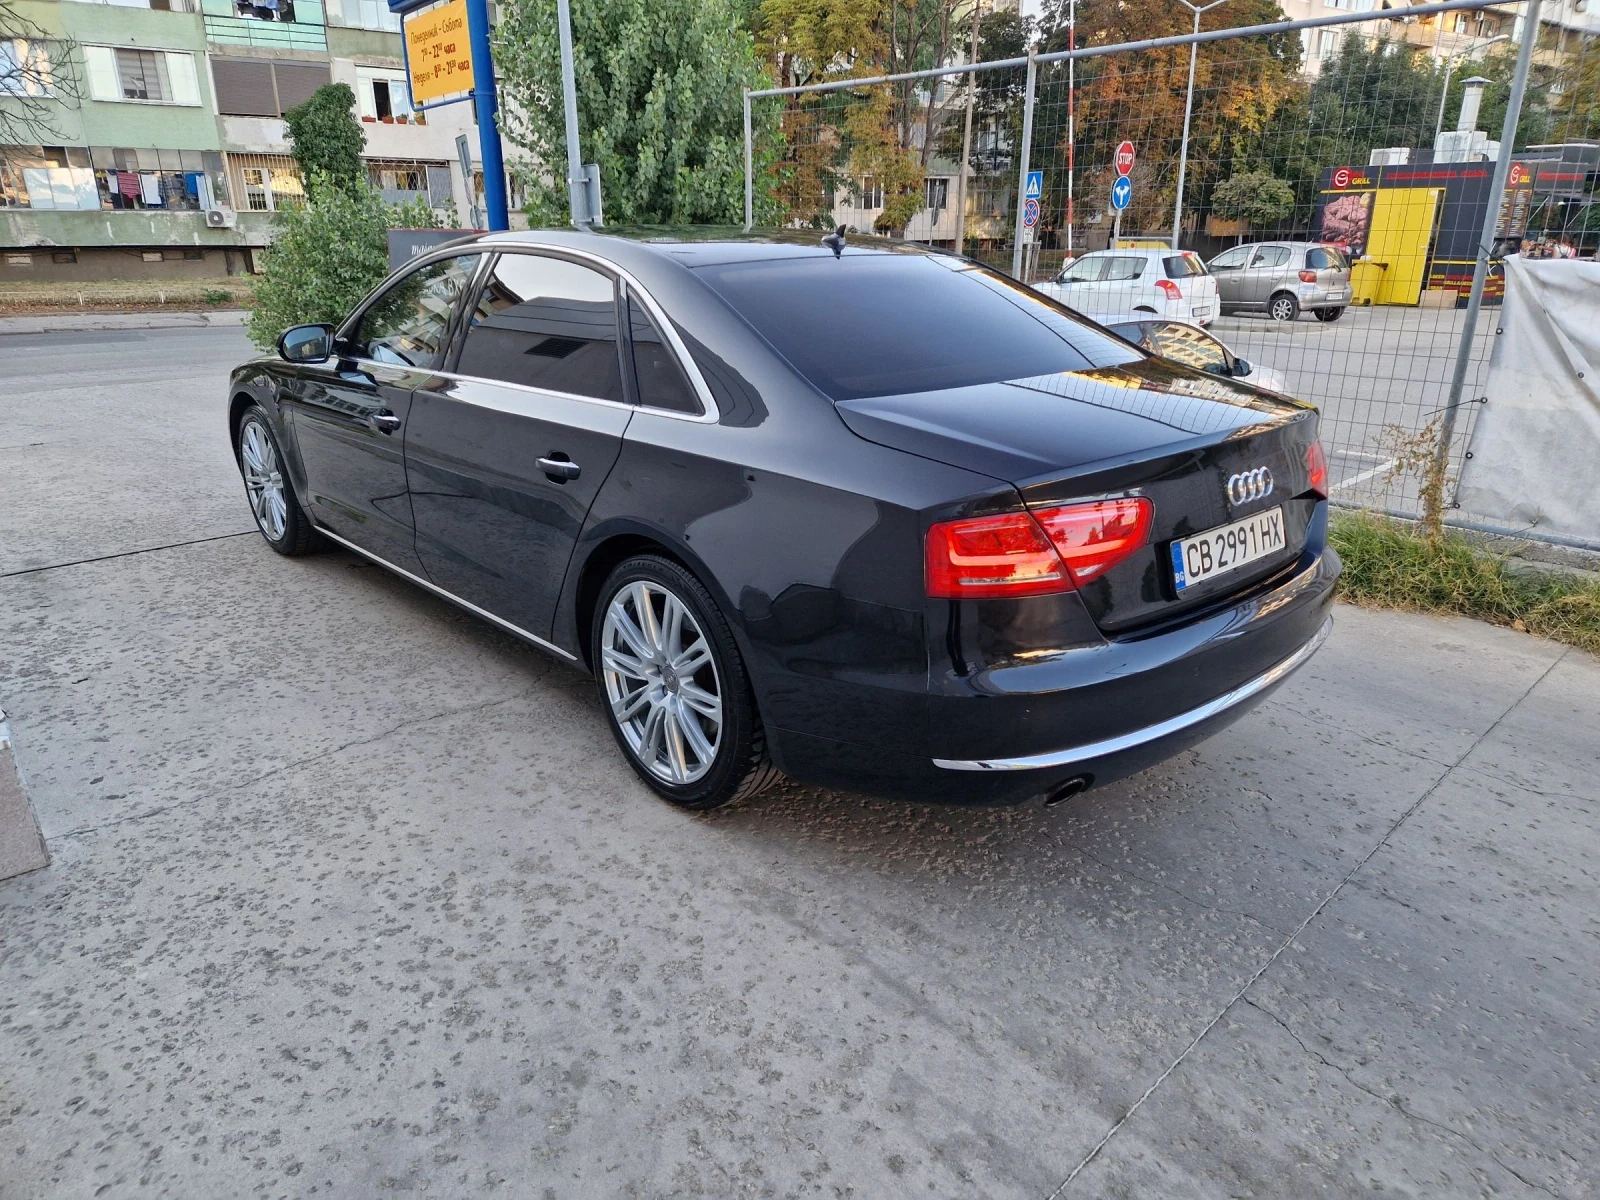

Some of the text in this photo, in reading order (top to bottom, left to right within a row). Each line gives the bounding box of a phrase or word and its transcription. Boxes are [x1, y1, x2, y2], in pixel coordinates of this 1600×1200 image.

[442, 18, 462, 33] Събота
[444, 43, 456, 54] часа
[413, 72, 430, 86] Неделя
[457, 60, 470, 71] часа
[1119, 153, 1132, 165] STOP
[1352, 177, 1371, 185] GRILL
[1187, 513, 1281, 578] CB 2991 HX
[1175, 571, 1185, 583] BG
